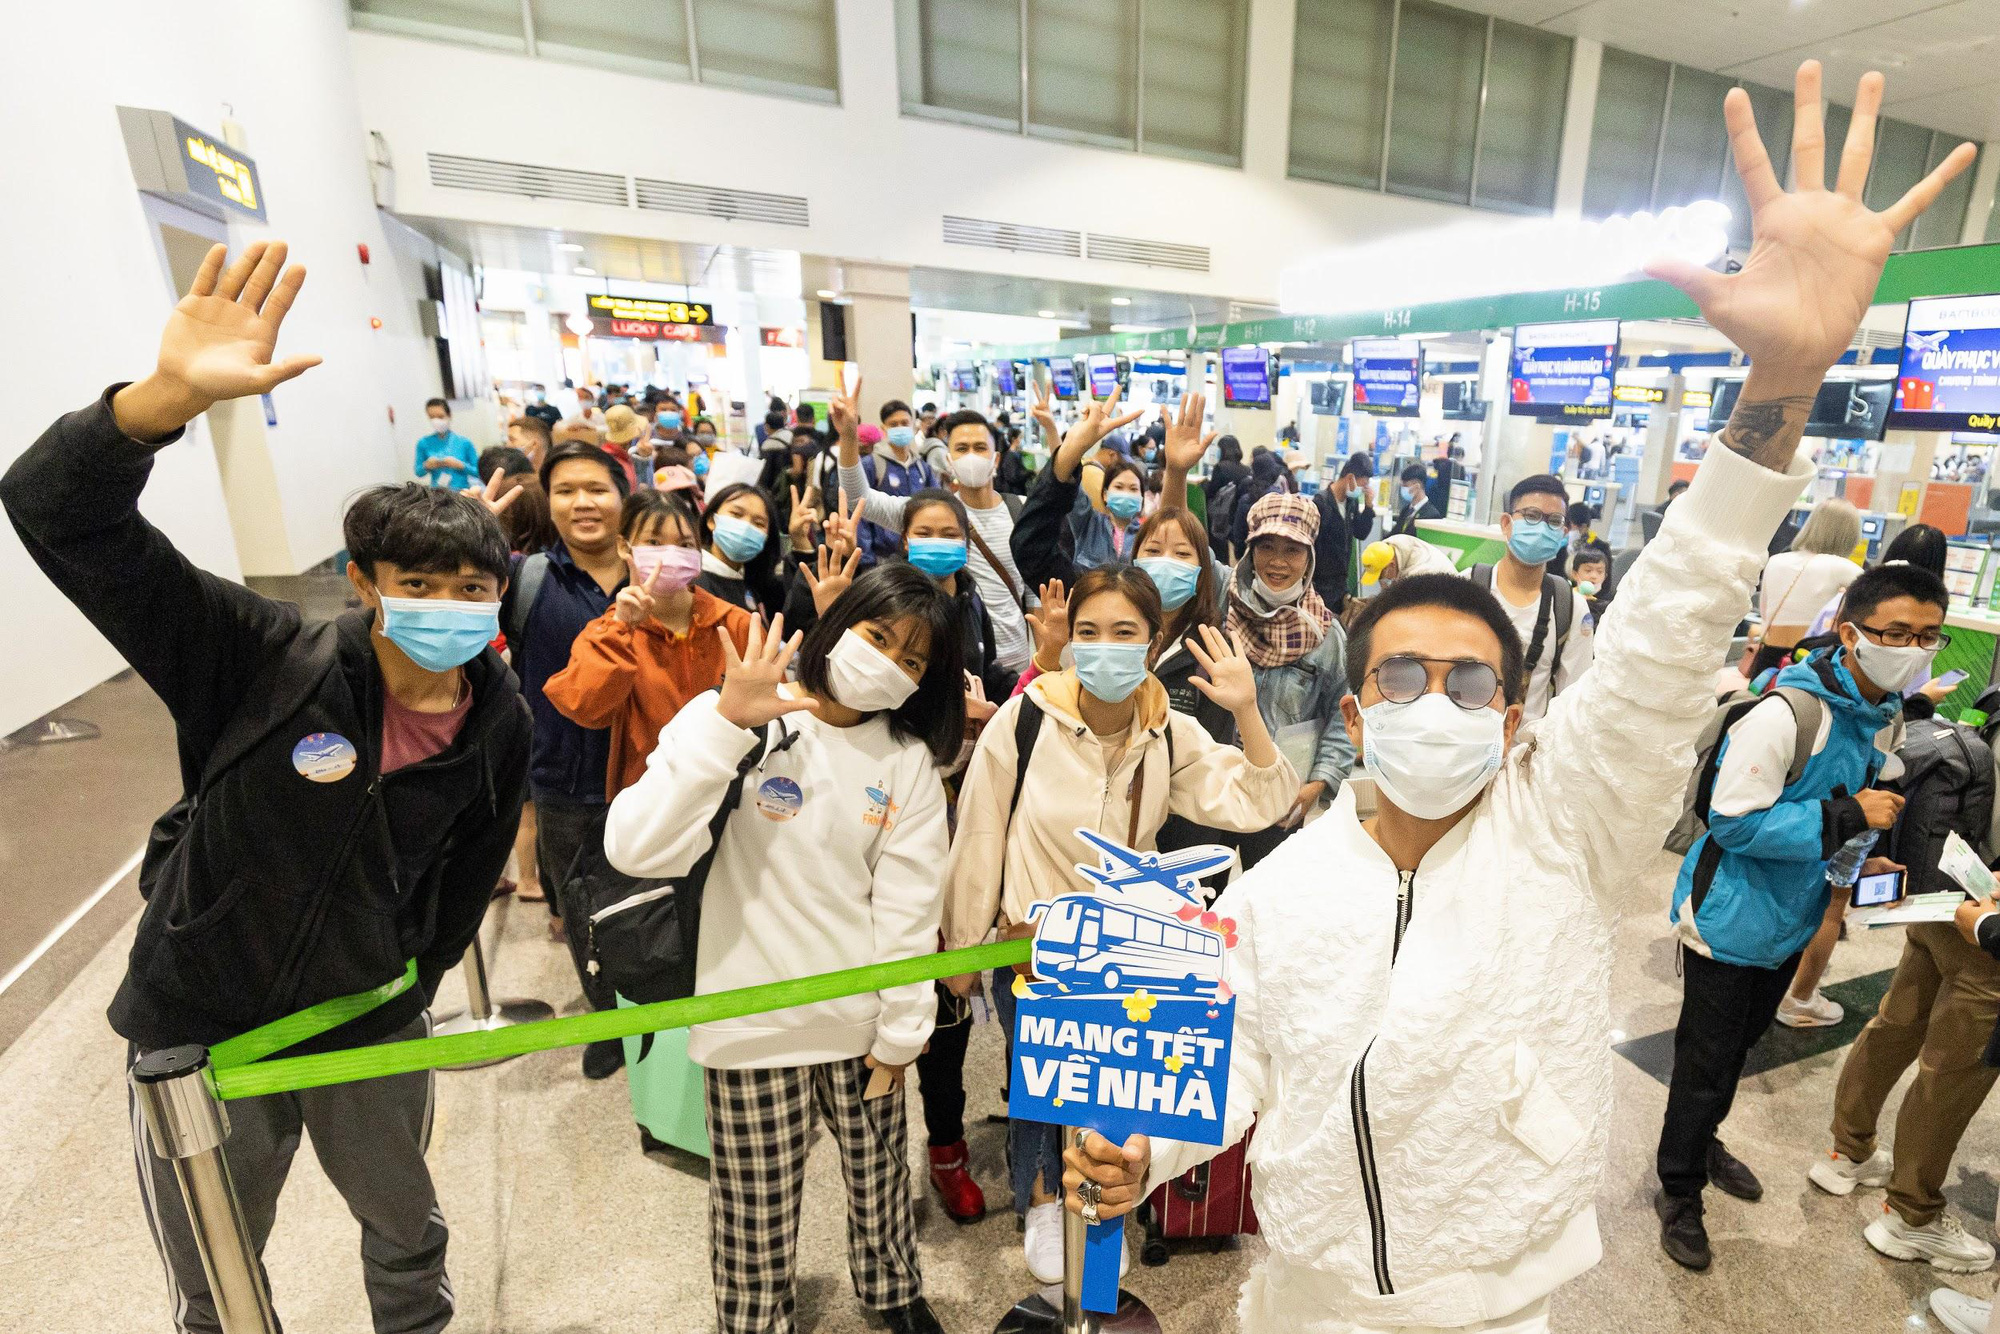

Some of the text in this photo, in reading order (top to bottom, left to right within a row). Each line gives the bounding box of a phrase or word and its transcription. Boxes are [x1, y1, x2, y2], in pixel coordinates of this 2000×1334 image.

[1564, 291, 1601, 311] H-15
[612, 320, 659, 336] LUCKY
[1384, 309, 1411, 328] H-14
[1019, 1014, 1225, 1067] MANG TẾT
[1020, 1053, 1217, 1121] VỀ NHÀ
